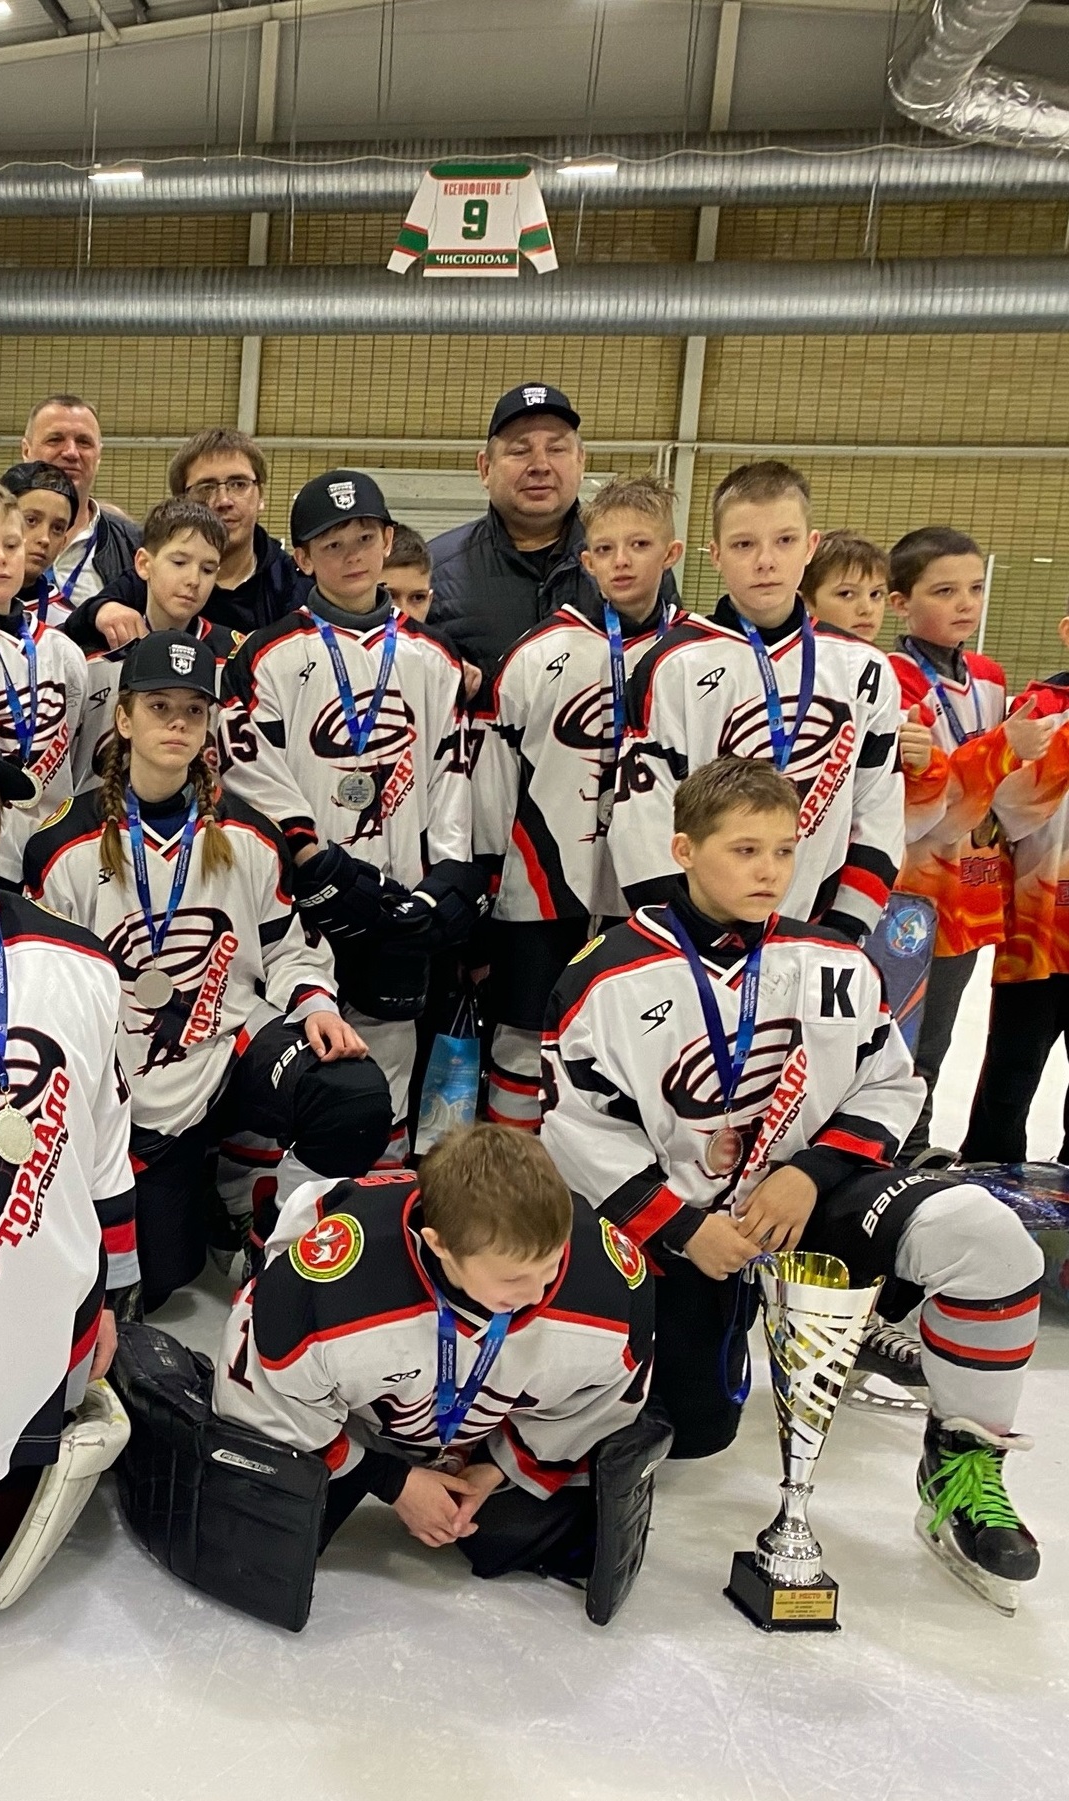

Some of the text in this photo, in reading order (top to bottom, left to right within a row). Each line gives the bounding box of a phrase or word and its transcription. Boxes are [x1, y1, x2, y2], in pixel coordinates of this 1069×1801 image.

[436, 254, 509, 265] ЧИСТОПОЛЬ
[462, 199, 489, 240] 9
[794, 724, 855, 842] ОРНАДО
[183, 935, 239, 1045] ТОРНАДО
[27, 1128, 69, 1238] ЧИСТОПОЛЬ
